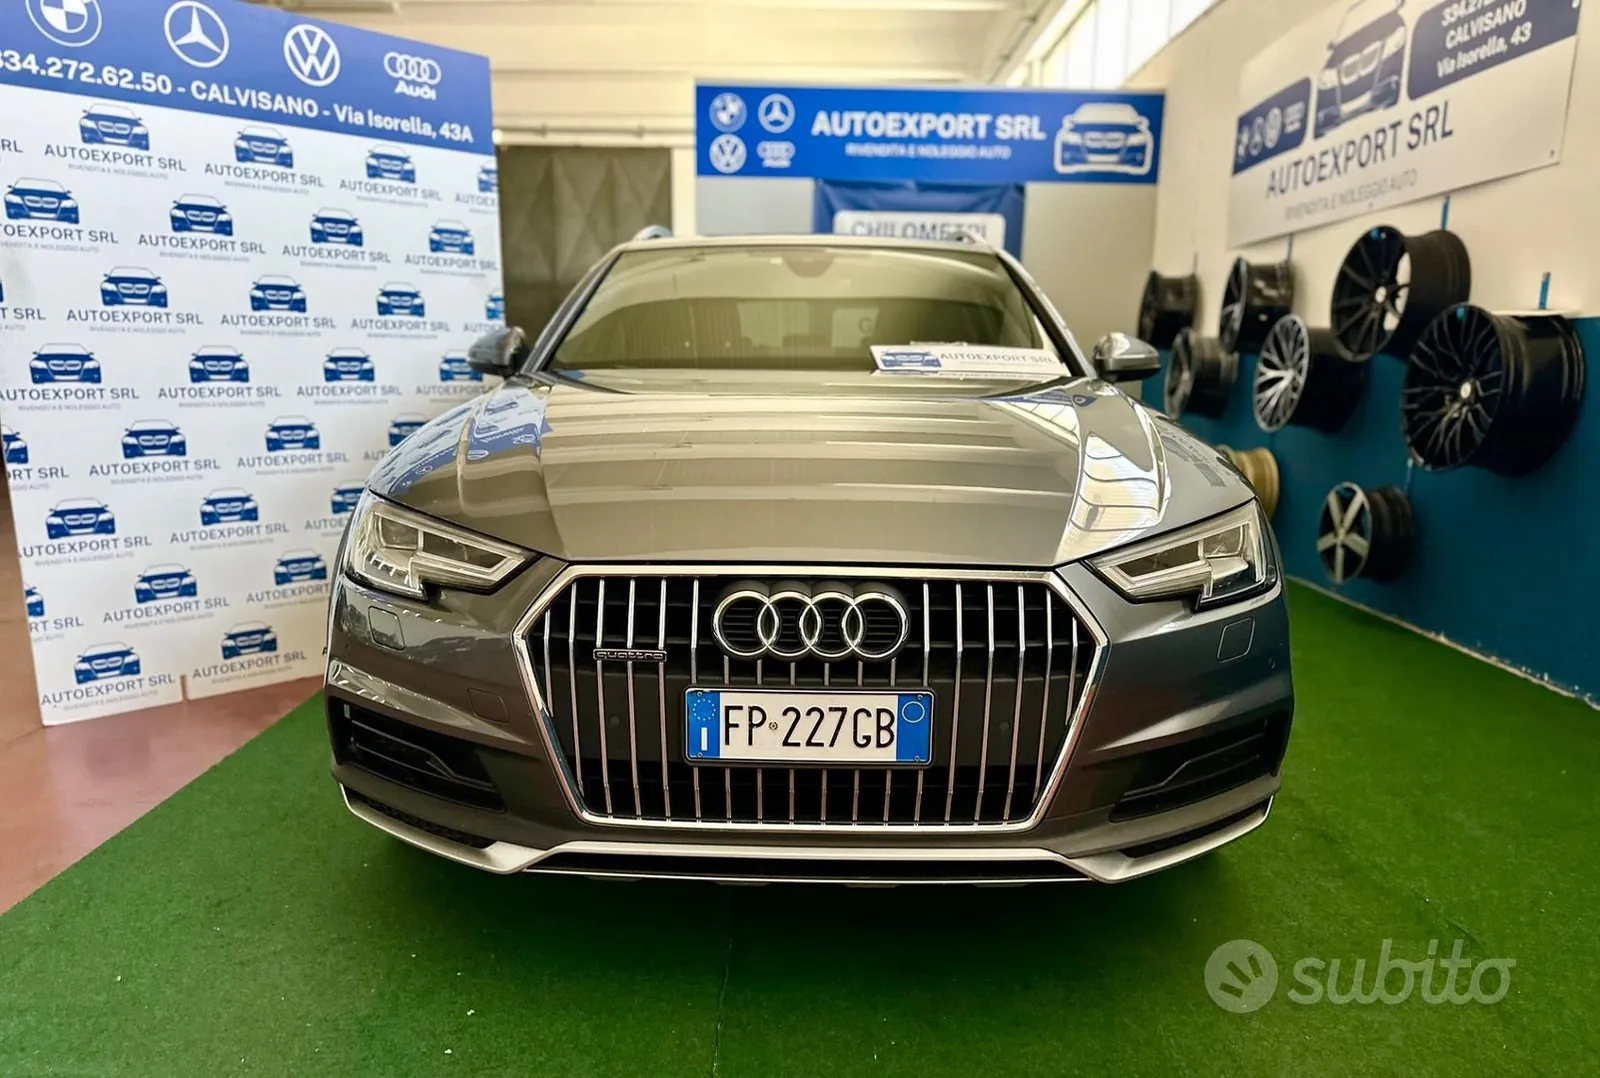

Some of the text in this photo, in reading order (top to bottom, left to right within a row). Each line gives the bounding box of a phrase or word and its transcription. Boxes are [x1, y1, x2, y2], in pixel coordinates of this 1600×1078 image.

[1445, 0, 1526, 49] CALVISANO
[1510, 21, 1533, 45] 43
[0, 49, 172, 95] 34.272.62.50
[191, 80, 318, 118] CALVISANO
[333, 104, 364, 126] Via
[368, 110, 437, 139] Isorella,
[439, 122, 474, 143] 43A
[395, 80, 436, 100] Audi
[811, 110, 1047, 140] AUTOEXPORT SRL
[44, 144, 188, 172] AUTOEXPORT SRL
[1266, 100, 1454, 198] AUTOEXPORT SRL
[204, 163, 296, 184] AUTOEXPORT
[300, 174, 325, 188] SRL
[88, 230, 119, 244] SRL
[138, 234, 266, 254] AUTOEXPORT SRL
[282, 245, 366, 261] AUTOEXPORT
[13, 307, 47, 320] SRL
[67, 310, 204, 325] AUTOEXPORT SRL
[220, 314, 337, 329] AUTOEXPORT SRL
[110, 387, 140, 399] SRL
[158, 386, 282, 399] AUTOEXPORT SRL
[296, 385, 378, 397] AUTOEXPORT
[89, 458, 222, 476] AUTOEXPORT SRL
[237, 453, 324, 468] AUTOEXPORT
[38, 466, 69, 479] SRL
[169, 522, 290, 543] AUTOEXPORT SRL
[304, 517, 349, 530] AUTOE
[18, 536, 152, 558] UTOEXPORT SRL
[103, 600, 201, 623] AUTOEXPORT
[204, 596, 231, 609] SRL
[53, 616, 84, 630] SRL
[596, 651, 664, 660] quattro
[193, 654, 281, 679] AUTOEXPORT
[41, 678, 145, 705] AUTOEXPORT
[724, 705, 896, 749] FP 227GB
